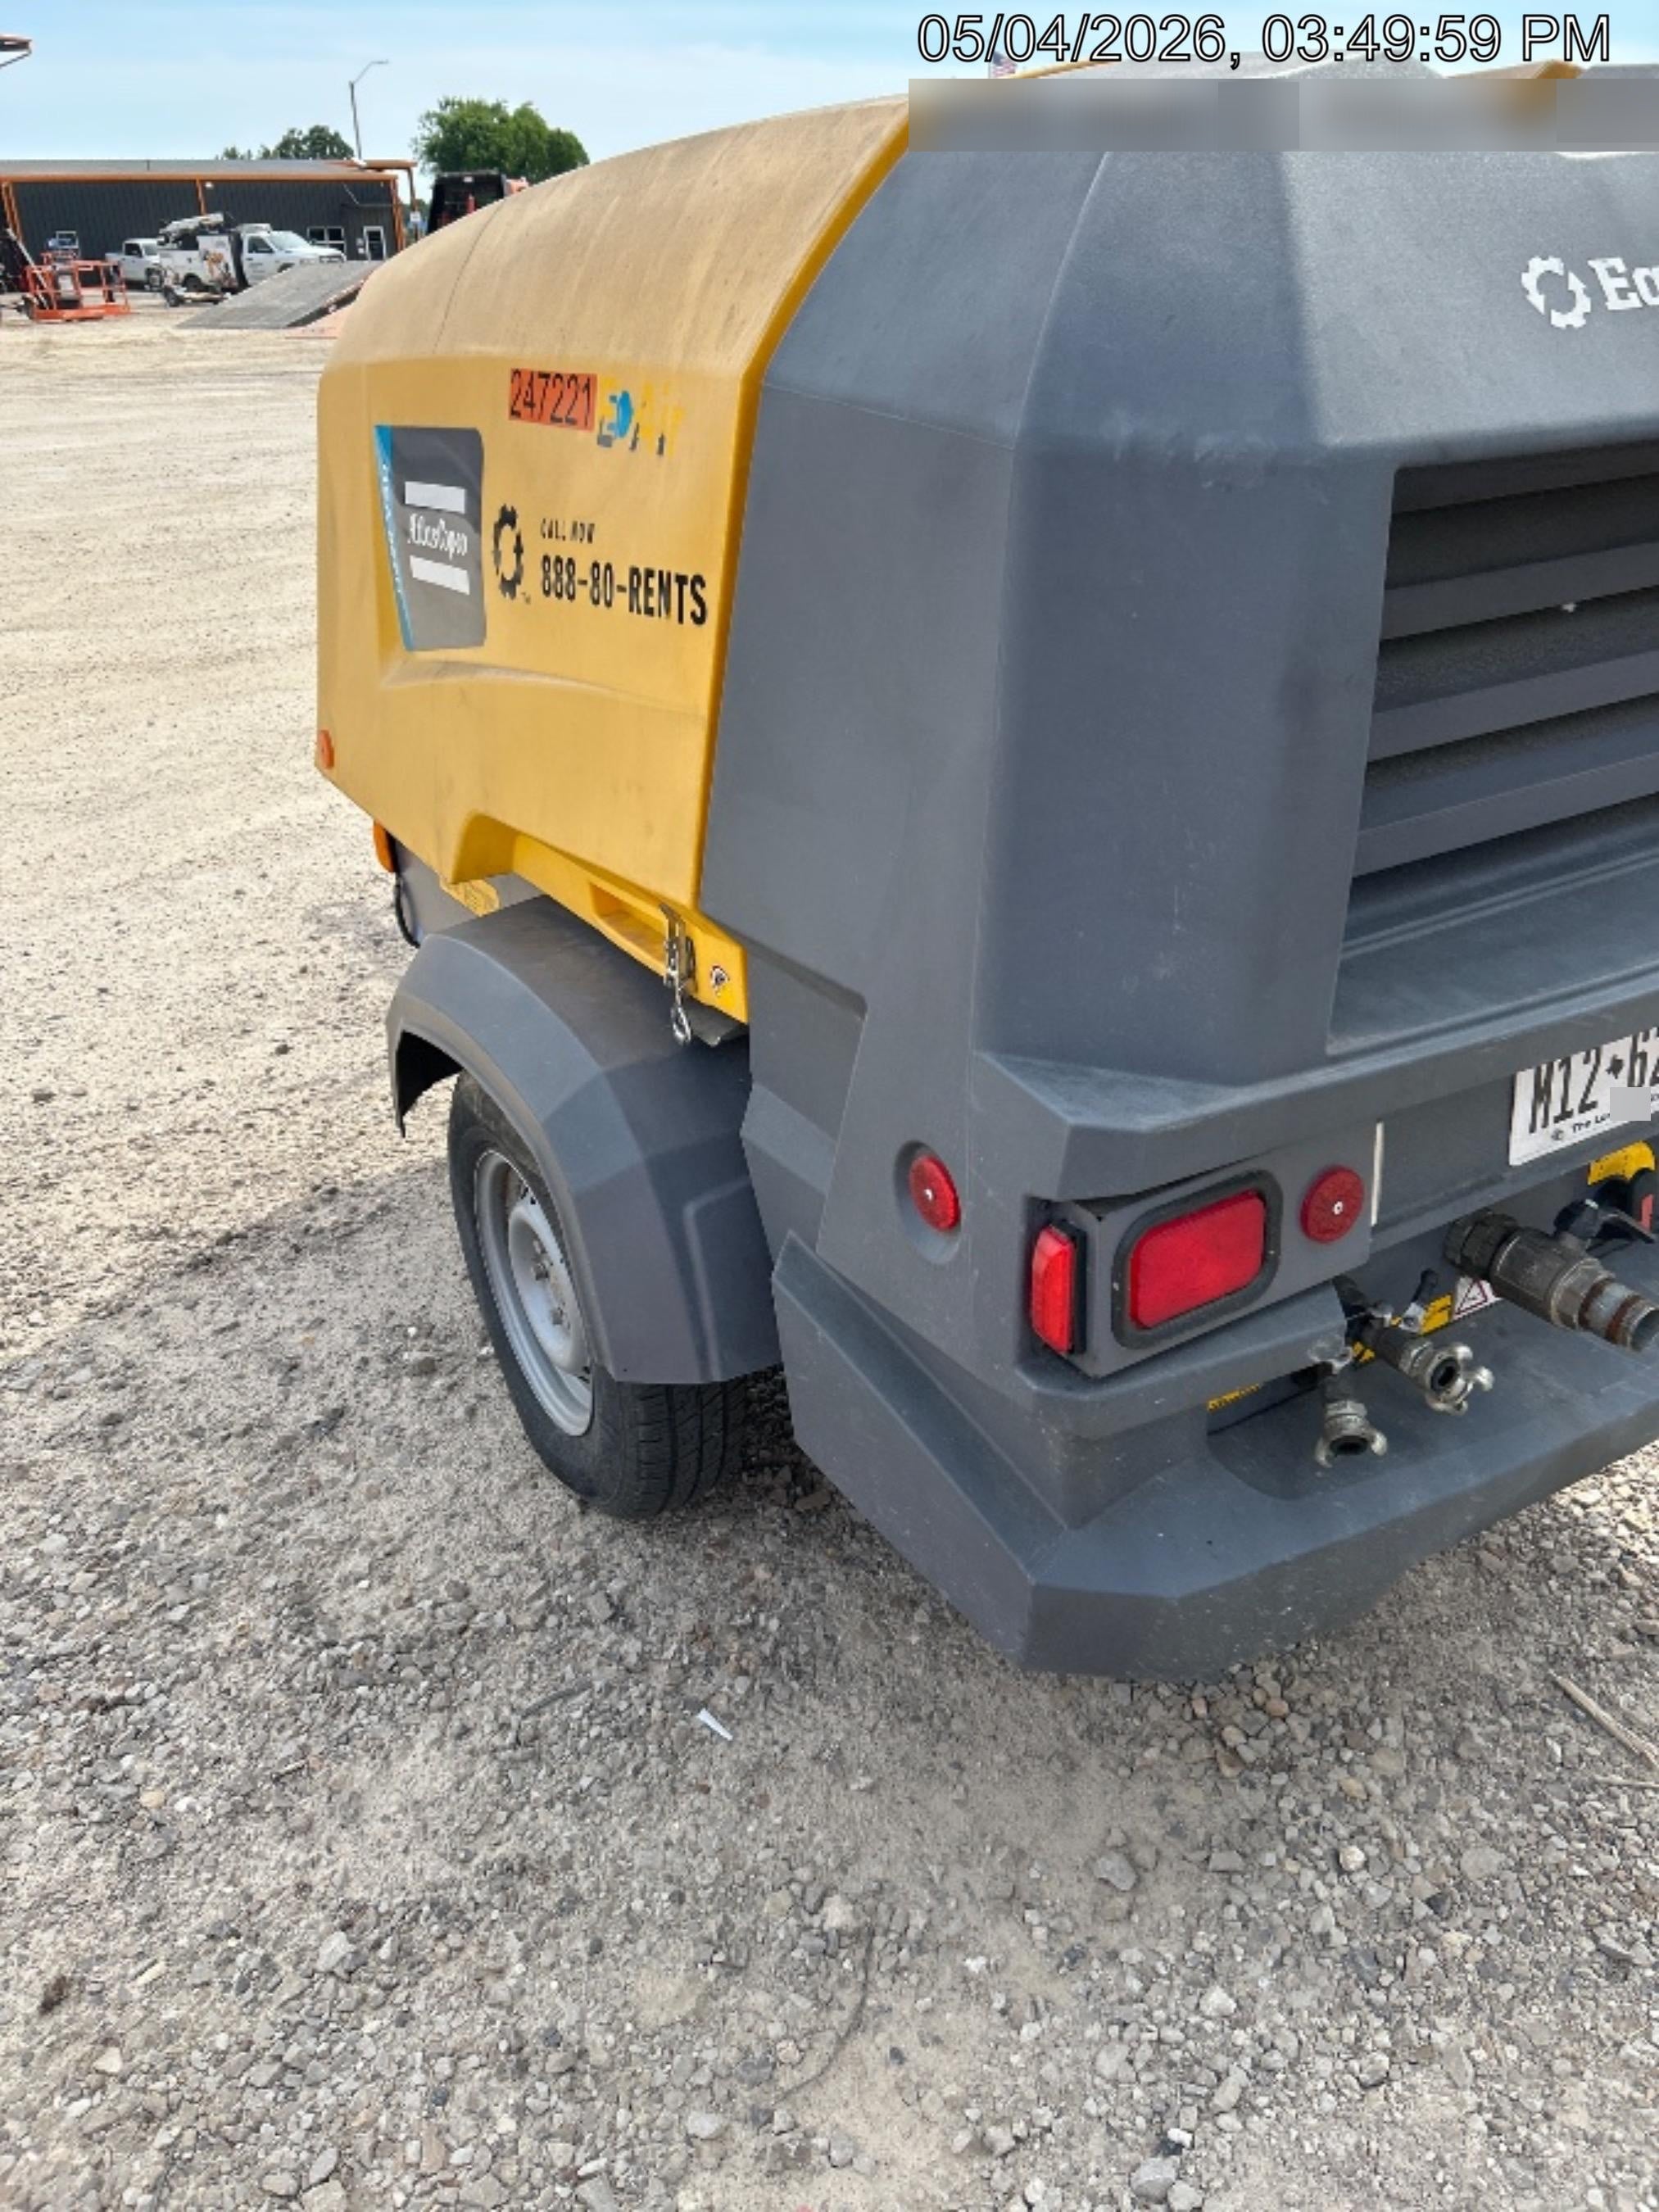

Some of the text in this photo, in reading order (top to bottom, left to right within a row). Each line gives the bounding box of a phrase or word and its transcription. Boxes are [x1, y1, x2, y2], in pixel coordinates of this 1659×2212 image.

[510, 369, 592, 427] 247221
[541, 518, 595, 544] CALL NOW
[541, 554, 707, 626] 888-80-RENTS
